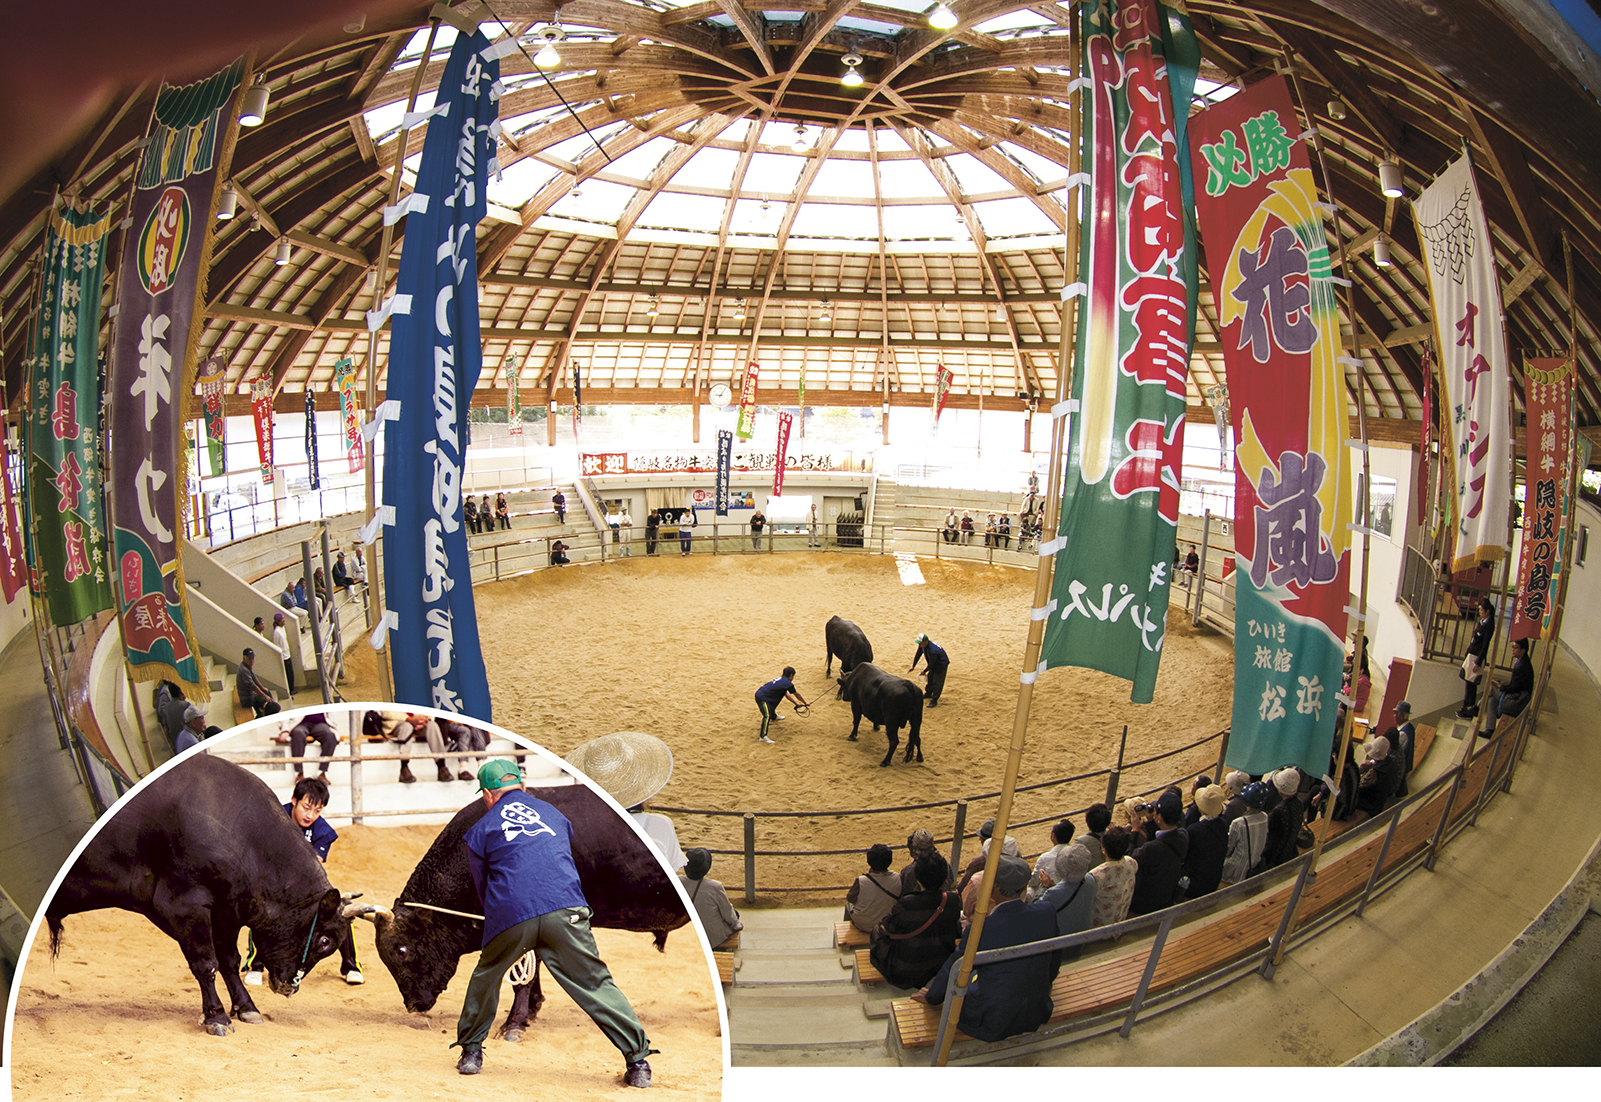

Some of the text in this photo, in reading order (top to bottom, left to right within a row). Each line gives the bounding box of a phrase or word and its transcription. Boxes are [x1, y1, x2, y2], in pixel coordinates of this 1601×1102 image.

[1200, 110, 1297, 197] 必勝
[1231, 227, 1340, 590] 花嵐
[582, 454, 626, 474] 歓迎
[1540, 409, 1556, 475] 横綱牛
[1524, 478, 1557, 621] 隠岐の島号
[1248, 618, 1287, 643] ひいき
[1252, 645, 1294, 673] 旅館
[1258, 673, 1325, 724] 松浜
